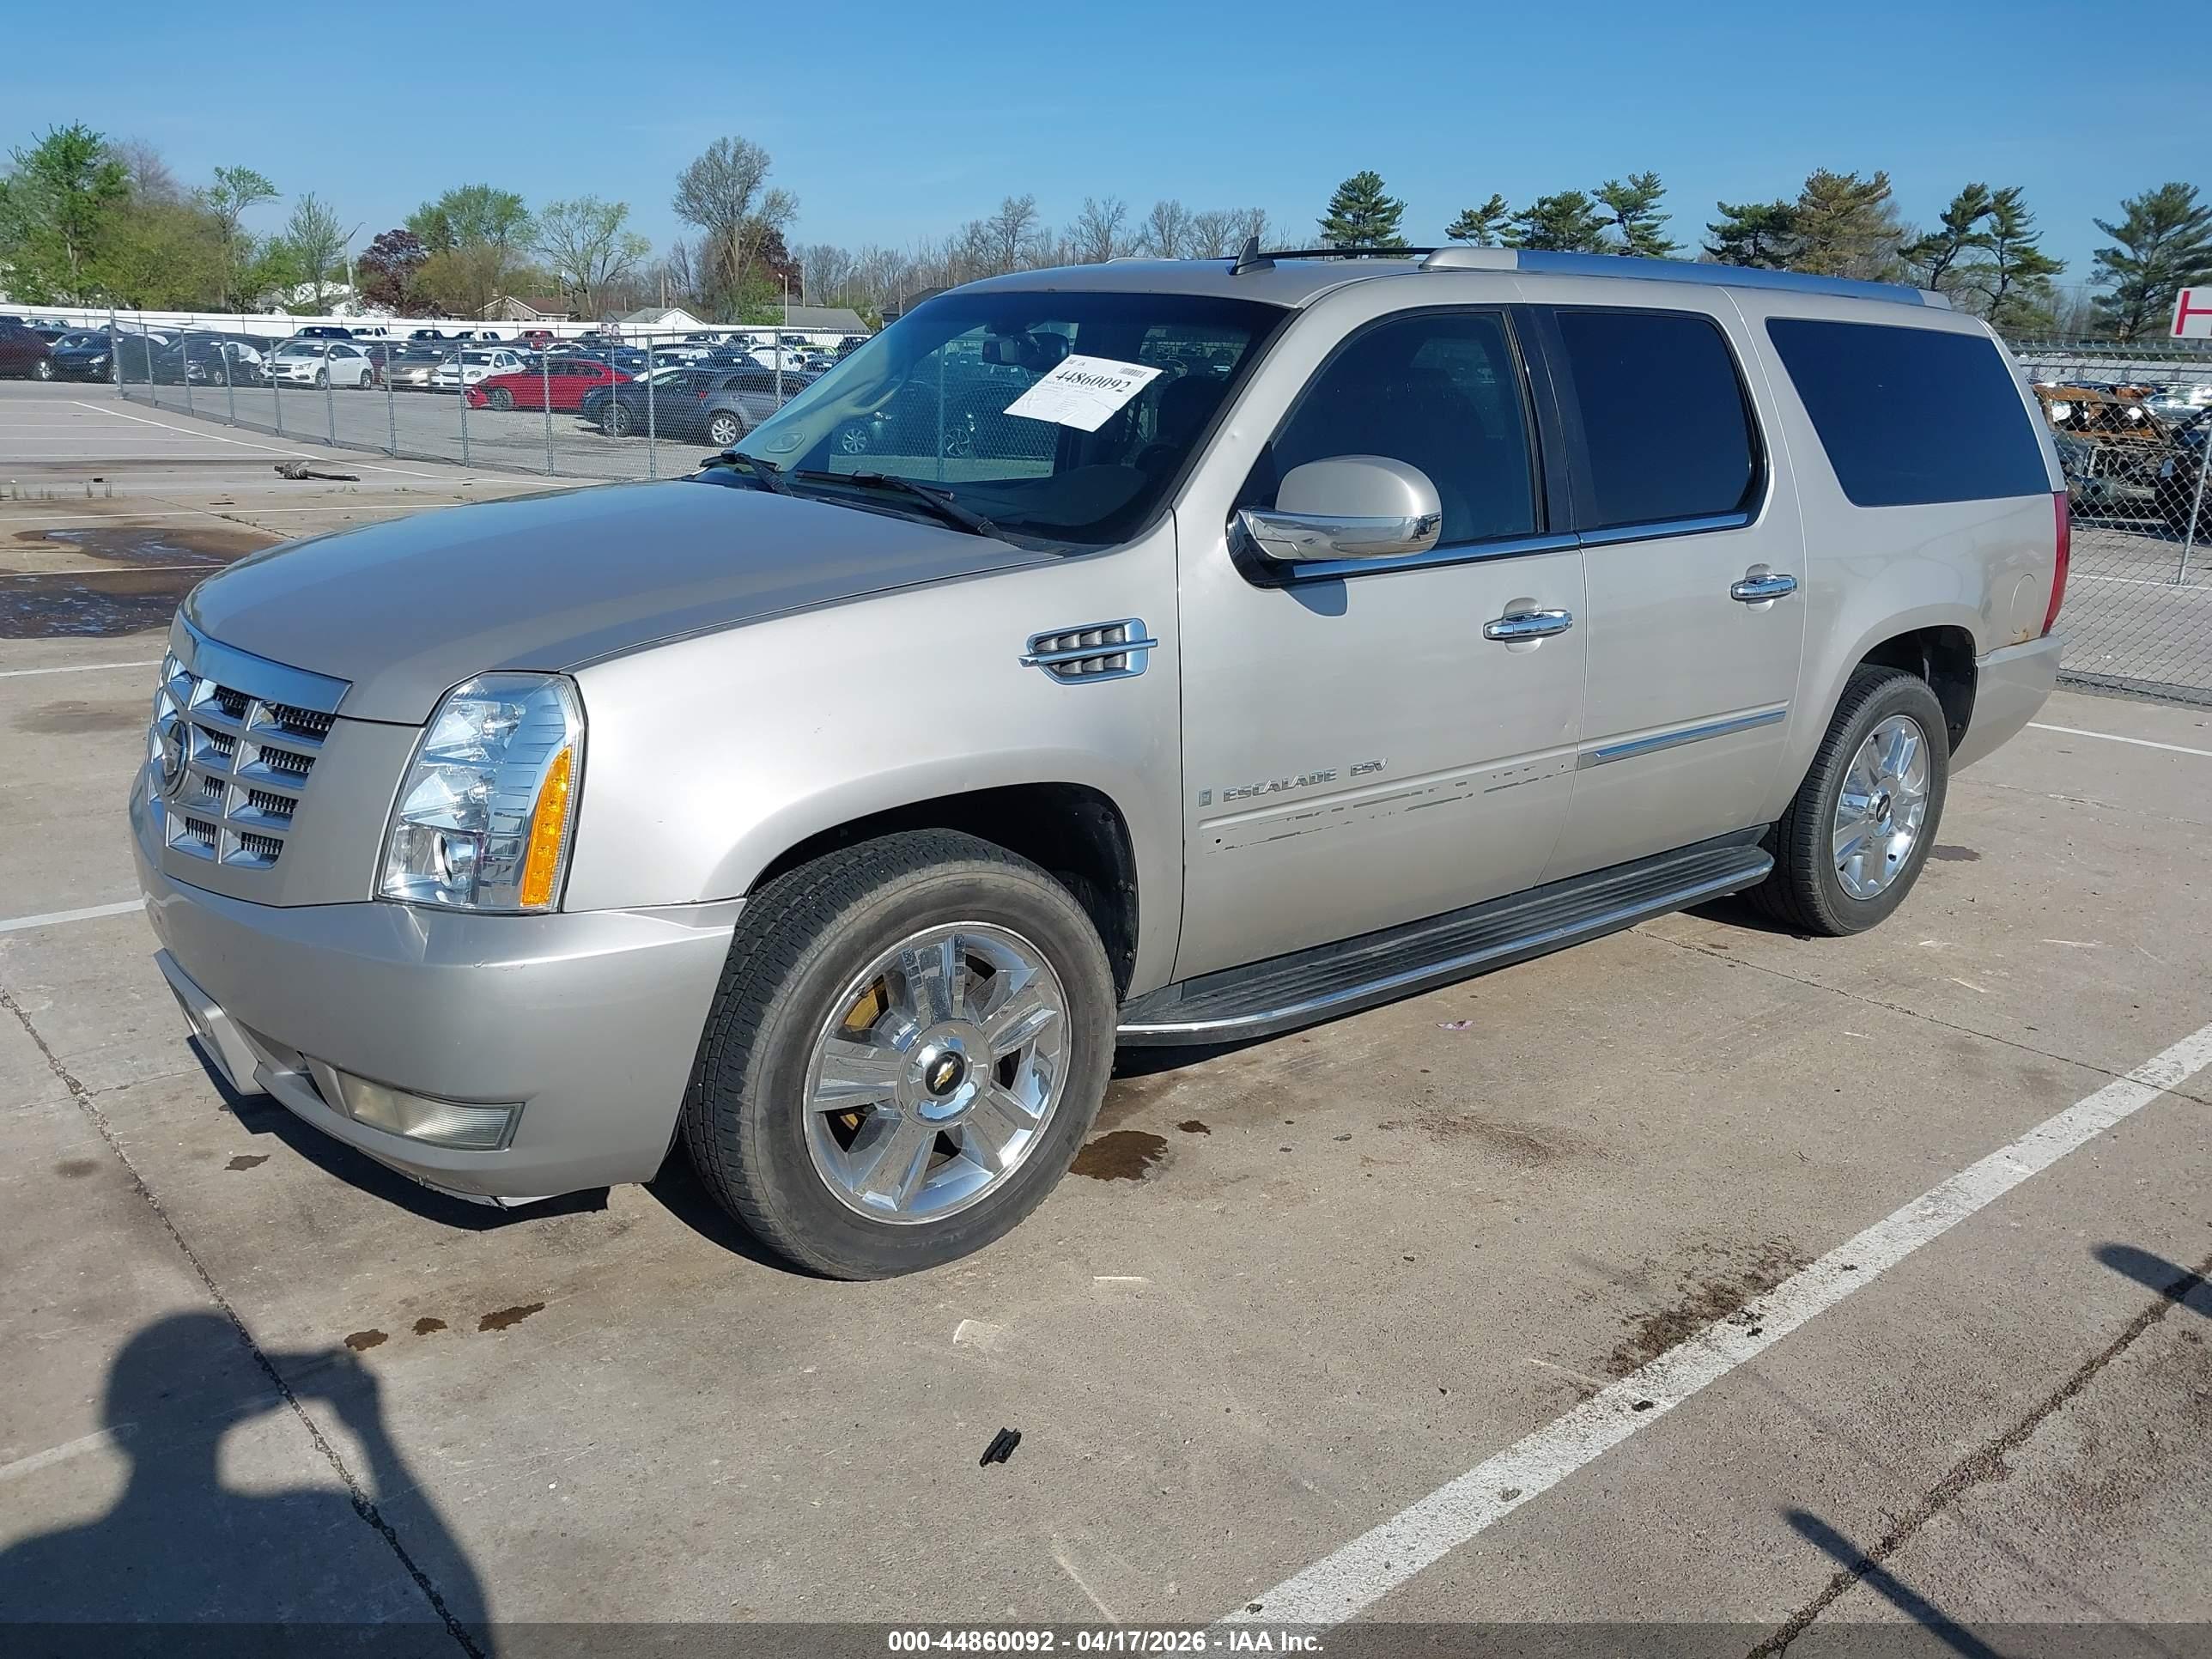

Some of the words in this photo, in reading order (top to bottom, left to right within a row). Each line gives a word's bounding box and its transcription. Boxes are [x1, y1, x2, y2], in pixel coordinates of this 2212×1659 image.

[1055, 370, 1131, 392] 44860092
[1223, 768, 1337, 802] ESCALADE
[1350, 757, 1388, 777] ESV
